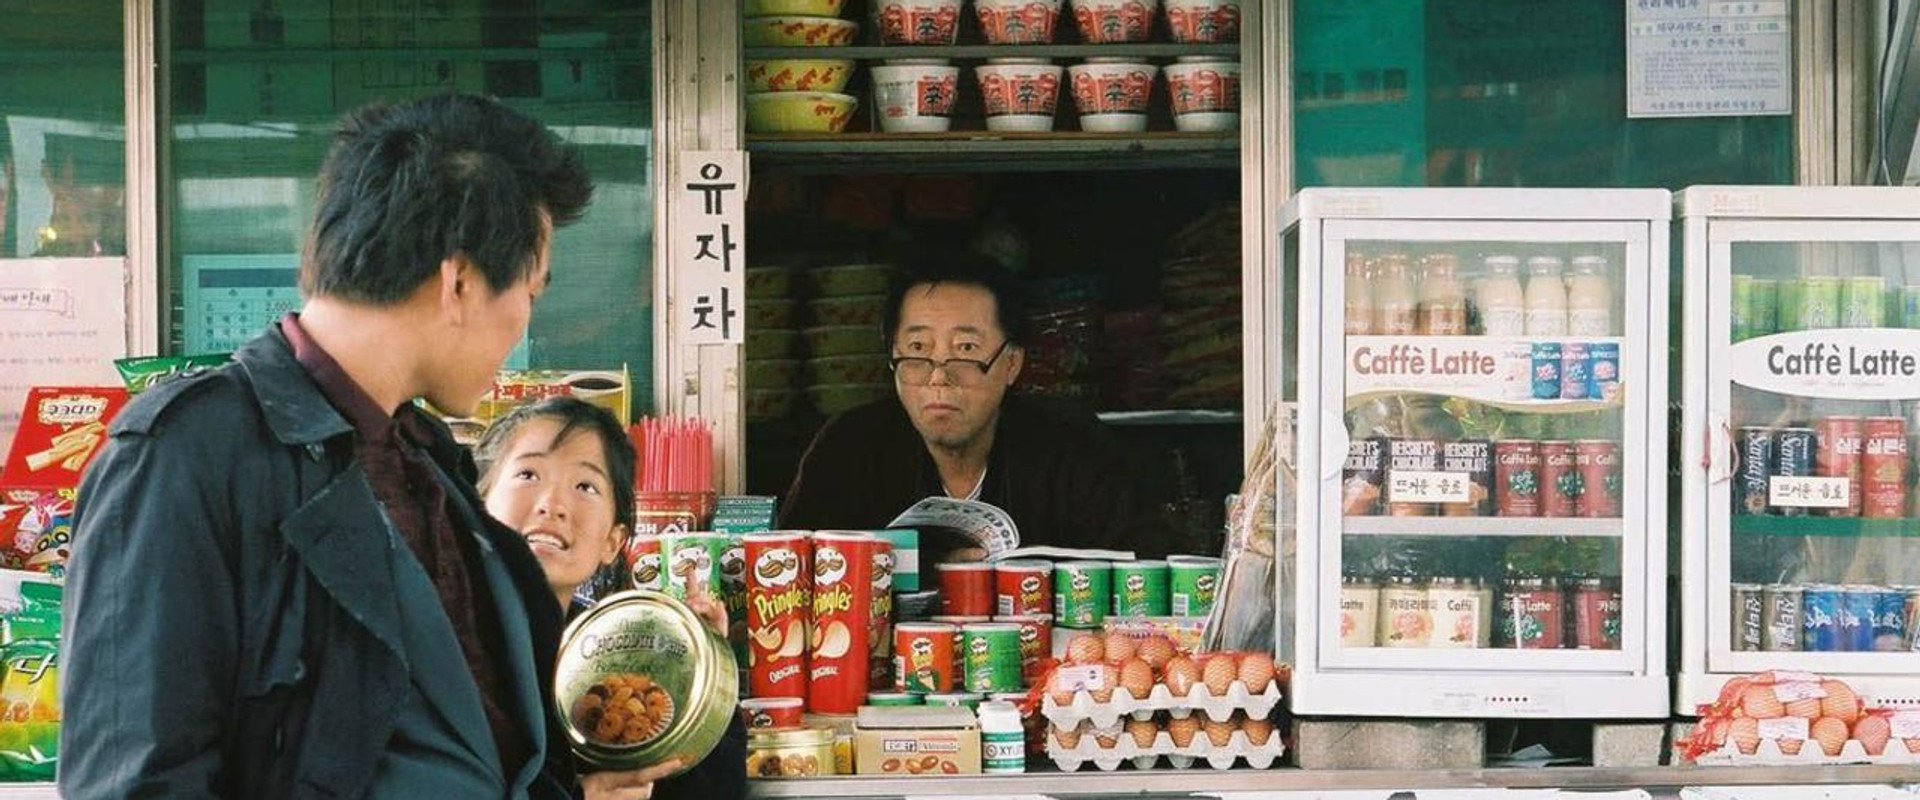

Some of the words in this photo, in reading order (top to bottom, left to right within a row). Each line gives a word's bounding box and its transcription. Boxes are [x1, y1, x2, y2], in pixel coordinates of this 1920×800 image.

[686, 163, 736, 340] 유자차
[1352, 344, 1425, 375] Caffè
[1430, 347, 1496, 375] Latte
[1767, 342, 1841, 376] Caffè
[1849, 346, 1916, 376] Latte
[755, 586, 811, 626] Pringles
